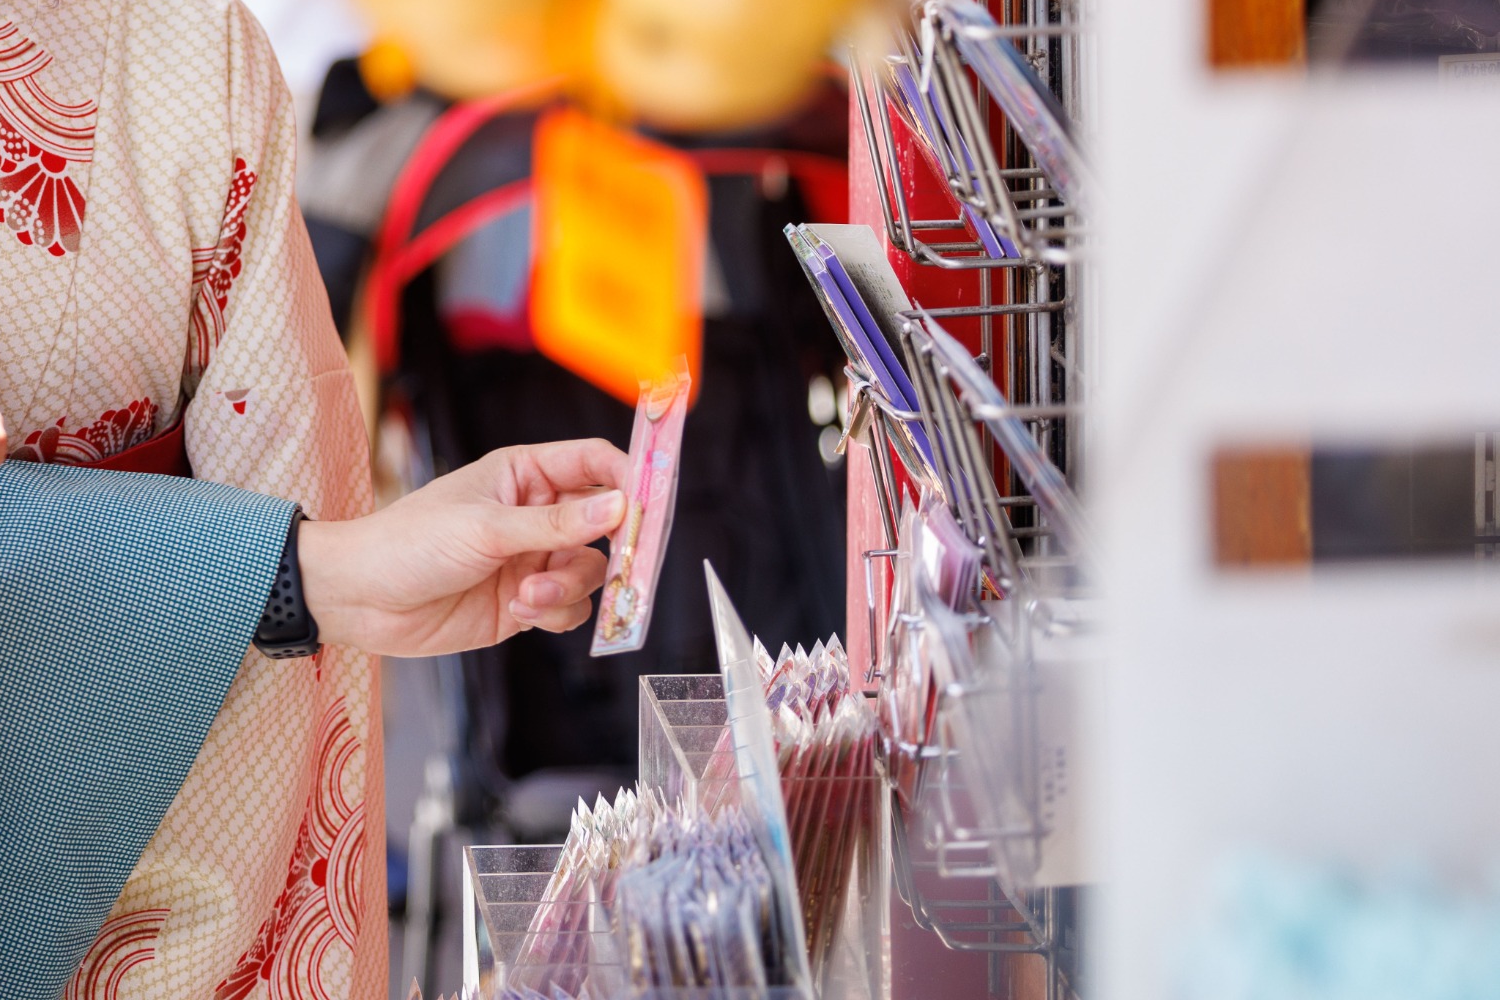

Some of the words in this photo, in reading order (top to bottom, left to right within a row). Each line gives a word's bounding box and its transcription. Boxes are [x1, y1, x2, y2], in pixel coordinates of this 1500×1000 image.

[1454, 62, 1500, 79] しあわせの
